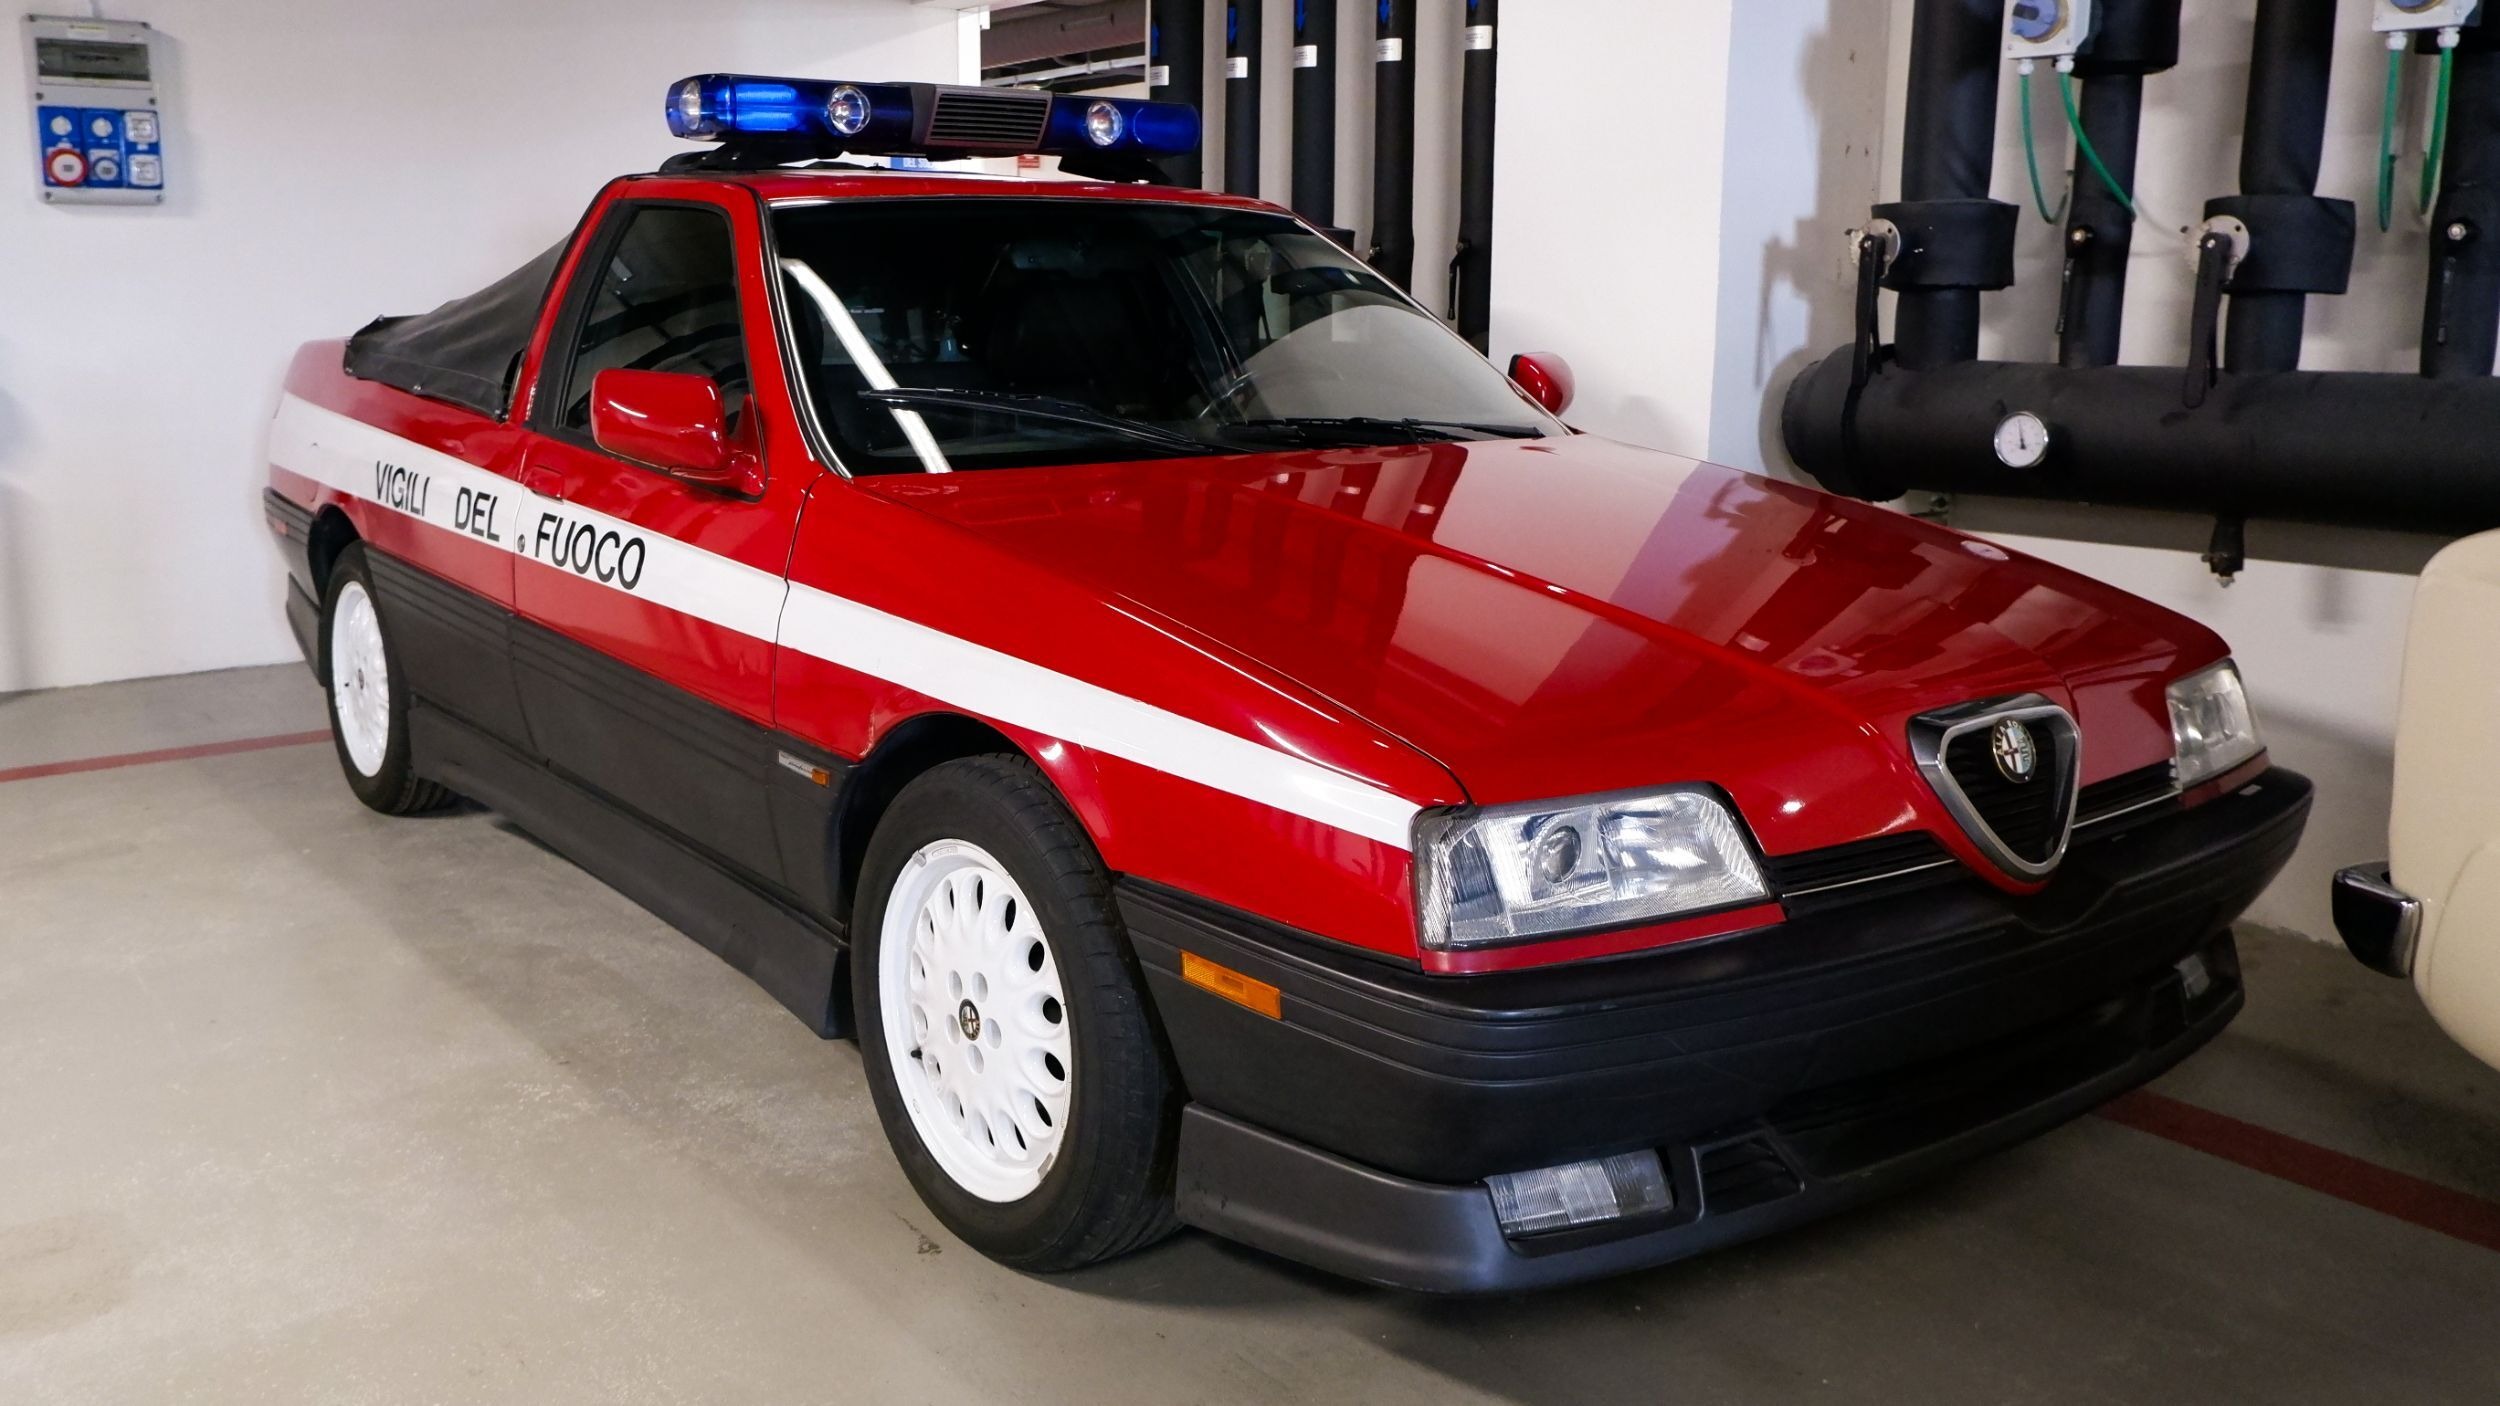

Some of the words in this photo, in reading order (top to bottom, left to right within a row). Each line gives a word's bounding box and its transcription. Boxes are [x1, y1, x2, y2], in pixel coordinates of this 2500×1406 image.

[376, 460, 430, 517] VIGILI
[454, 487, 500, 542] DEL
[535, 512, 646, 590] FUOCO
